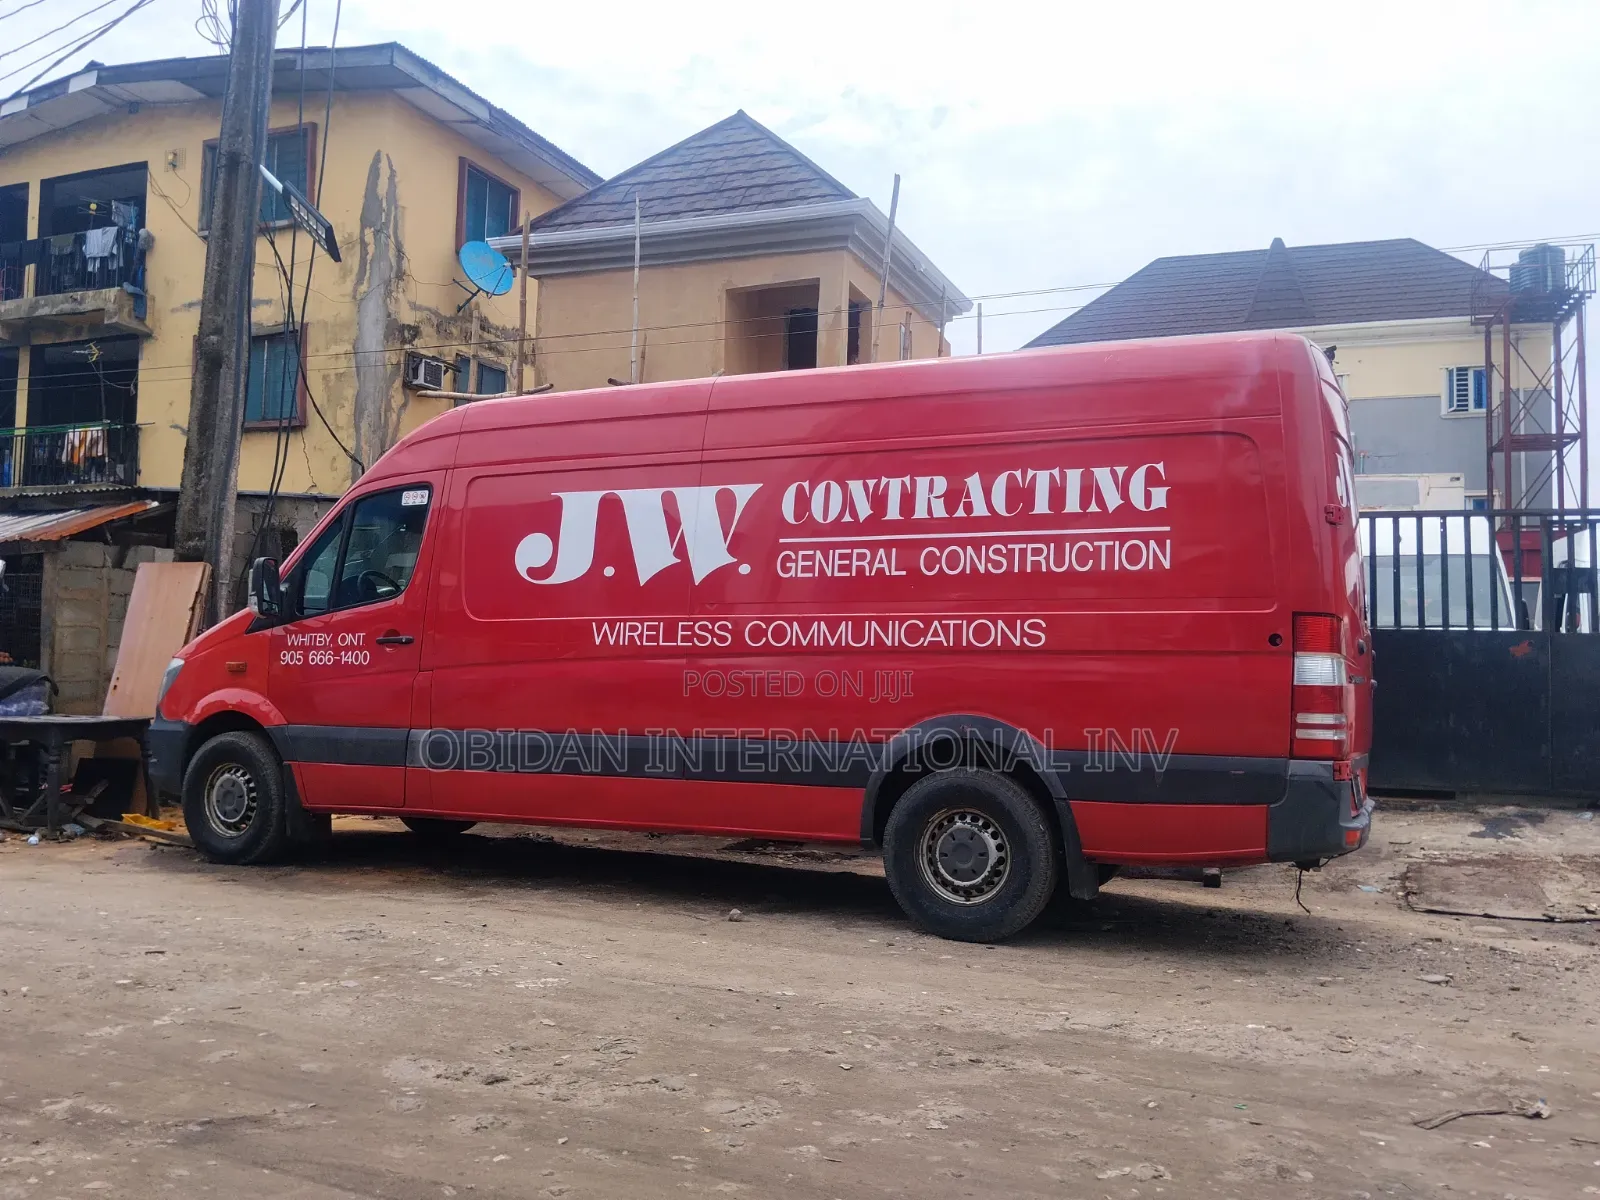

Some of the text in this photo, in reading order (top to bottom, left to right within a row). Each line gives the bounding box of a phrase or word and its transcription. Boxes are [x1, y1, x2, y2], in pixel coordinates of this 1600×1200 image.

[514, 460, 1171, 587] J.W. CONTRACTING
[776, 539, 1171, 578] GENERAL CONSTRUCTION
[287, 632, 366, 647] WHITBY, ONT.
[592, 619, 1048, 648] WIRELESS COMMUNICATIONS
[280, 650, 370, 665] 905 666-1400
